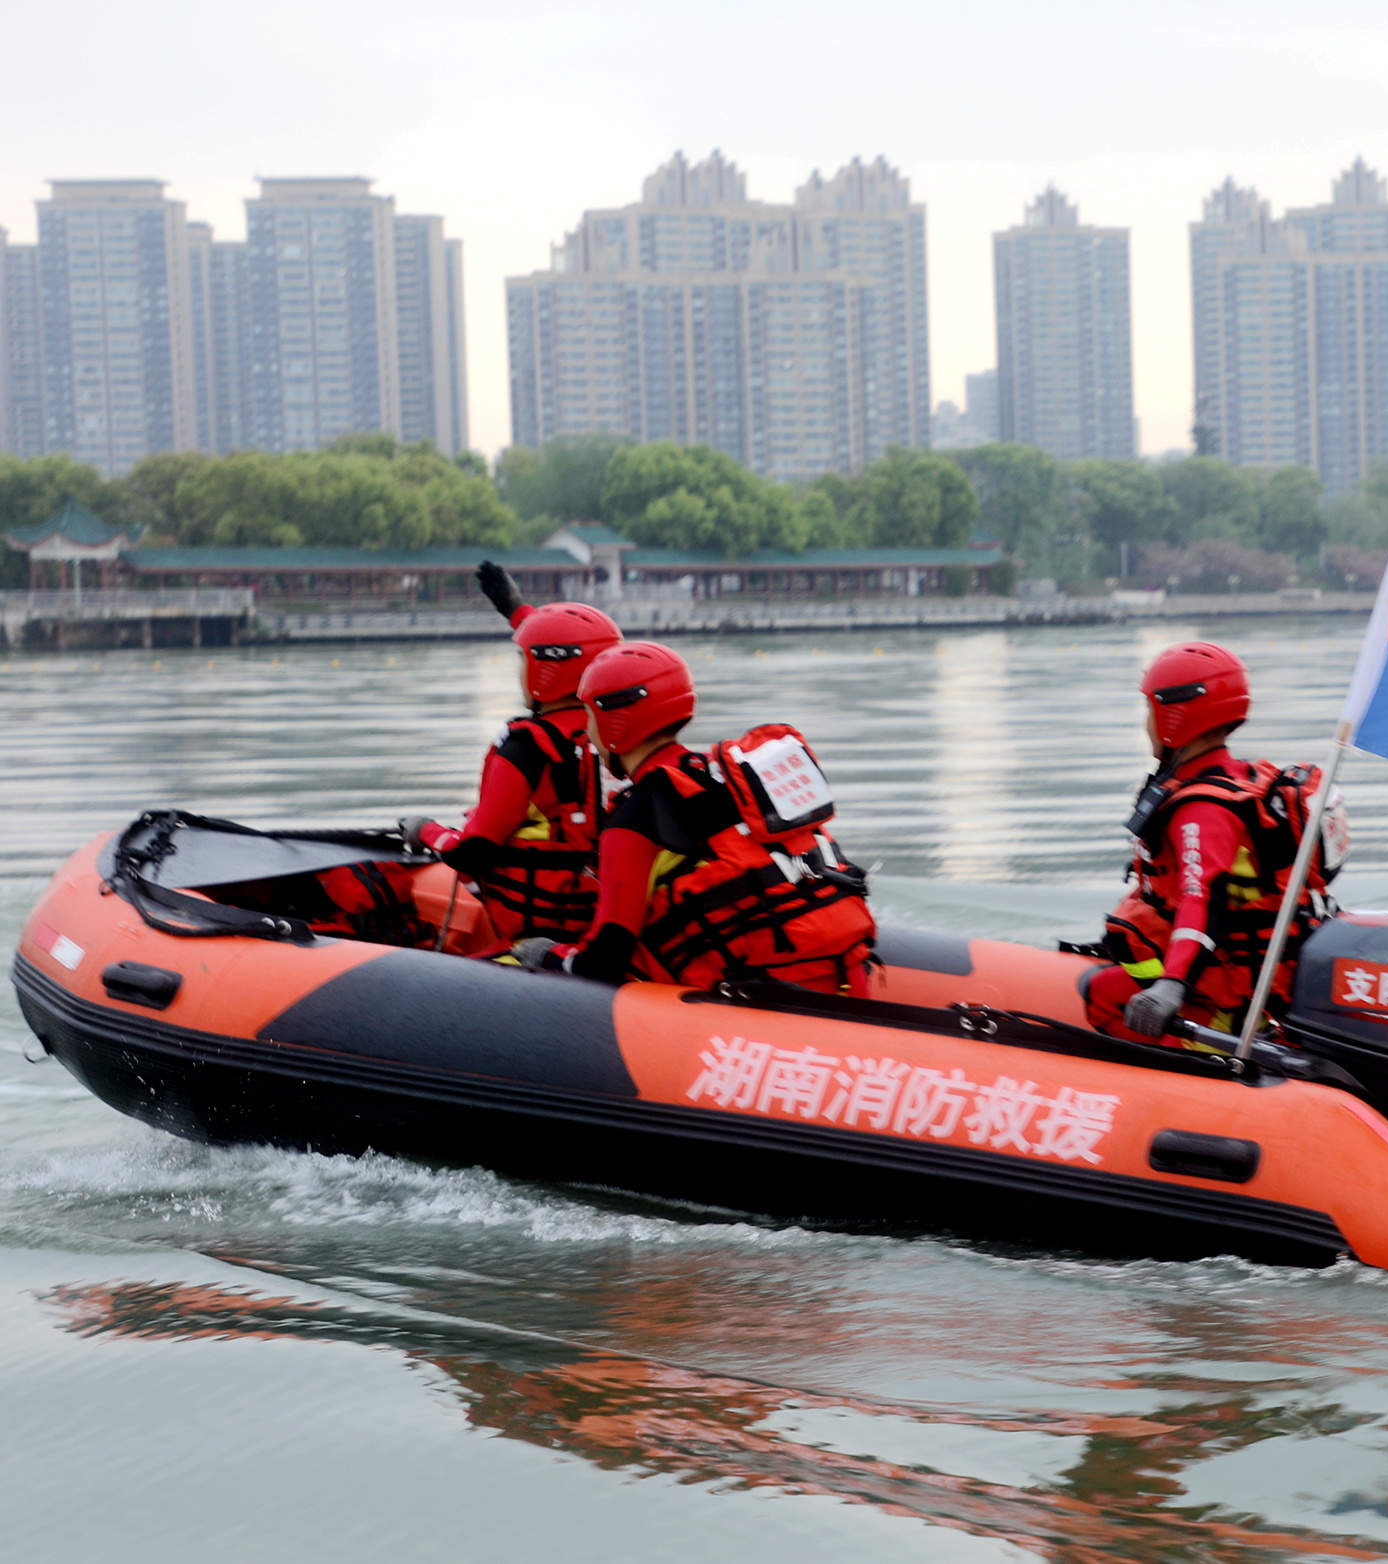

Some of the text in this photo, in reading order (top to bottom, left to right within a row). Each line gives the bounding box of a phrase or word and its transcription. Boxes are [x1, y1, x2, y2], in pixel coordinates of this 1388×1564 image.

[686, 1035, 1123, 1165] 湖南消防救援
